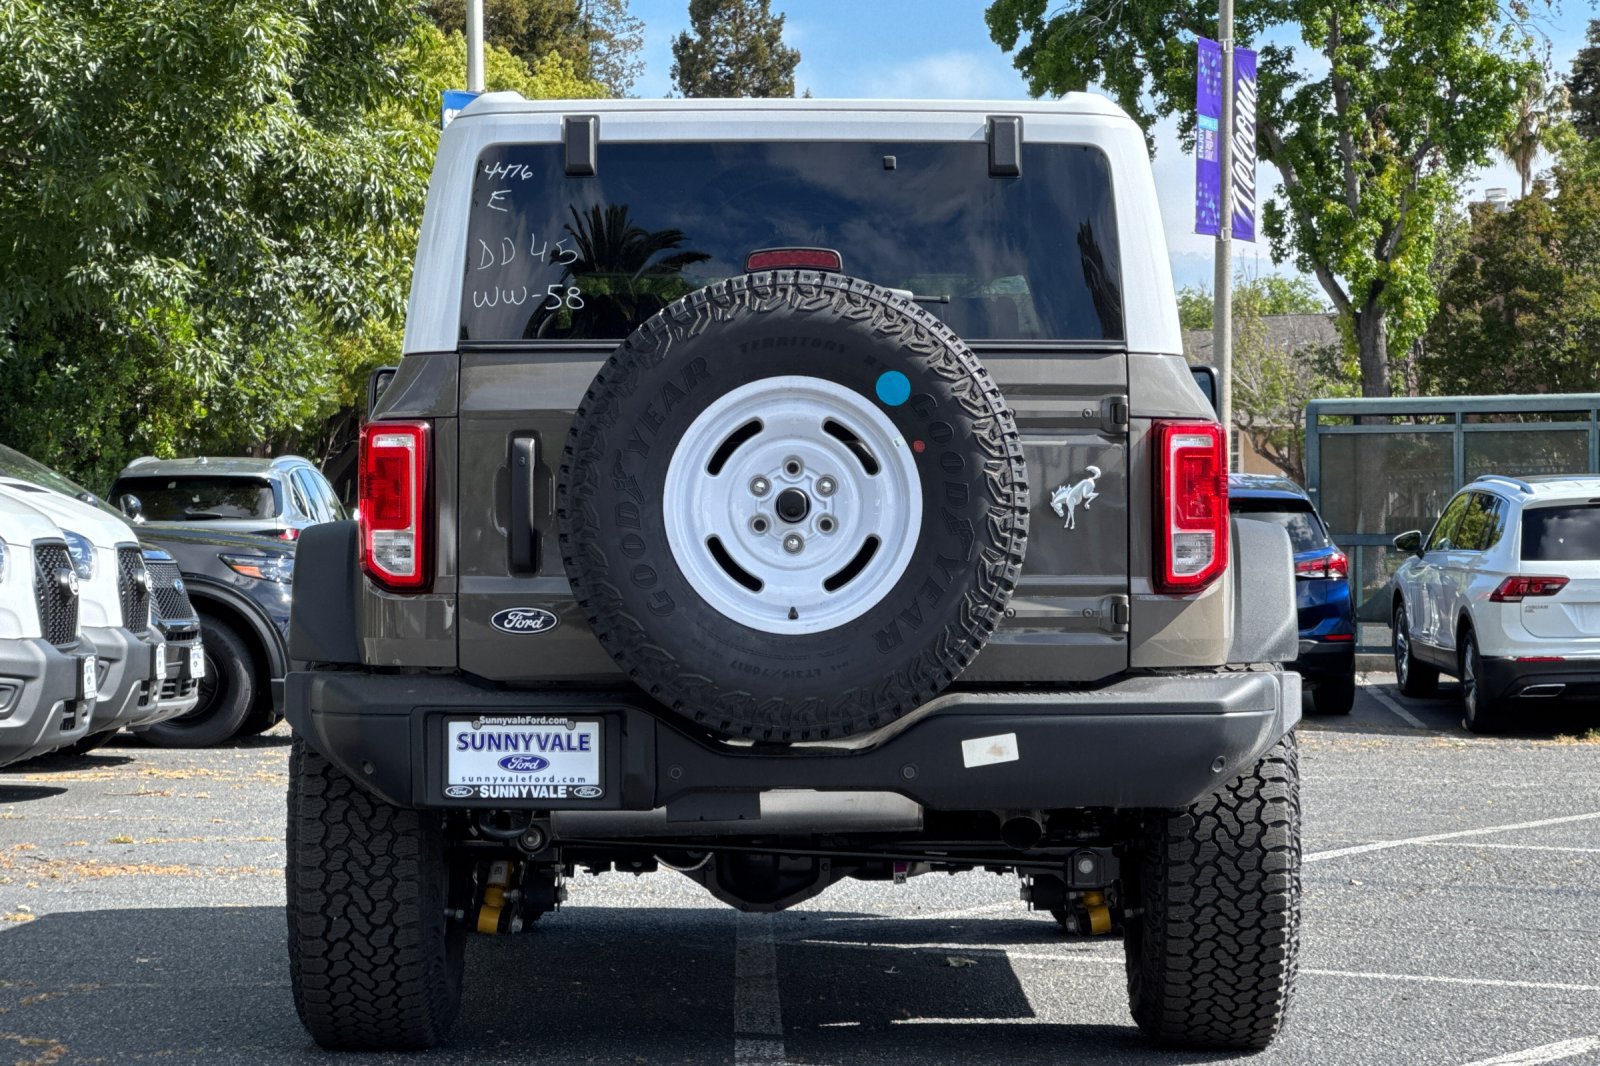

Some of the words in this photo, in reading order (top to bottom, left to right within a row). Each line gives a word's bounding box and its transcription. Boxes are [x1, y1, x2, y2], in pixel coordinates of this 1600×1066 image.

[484, 161, 534, 180] 4476
[486, 189, 512, 212] E
[738, 335, 848, 355] TERRITORY
[503, 610, 545, 629] Ford
[479, 716, 568, 726] SunnyvaleFord.com
[456, 731, 591, 752] SUNNYVALE
[507, 754, 540, 770] Ford
[461, 774, 586, 784] sunnyvaleford.com
[479, 785, 567, 798] SUNNYVALE
